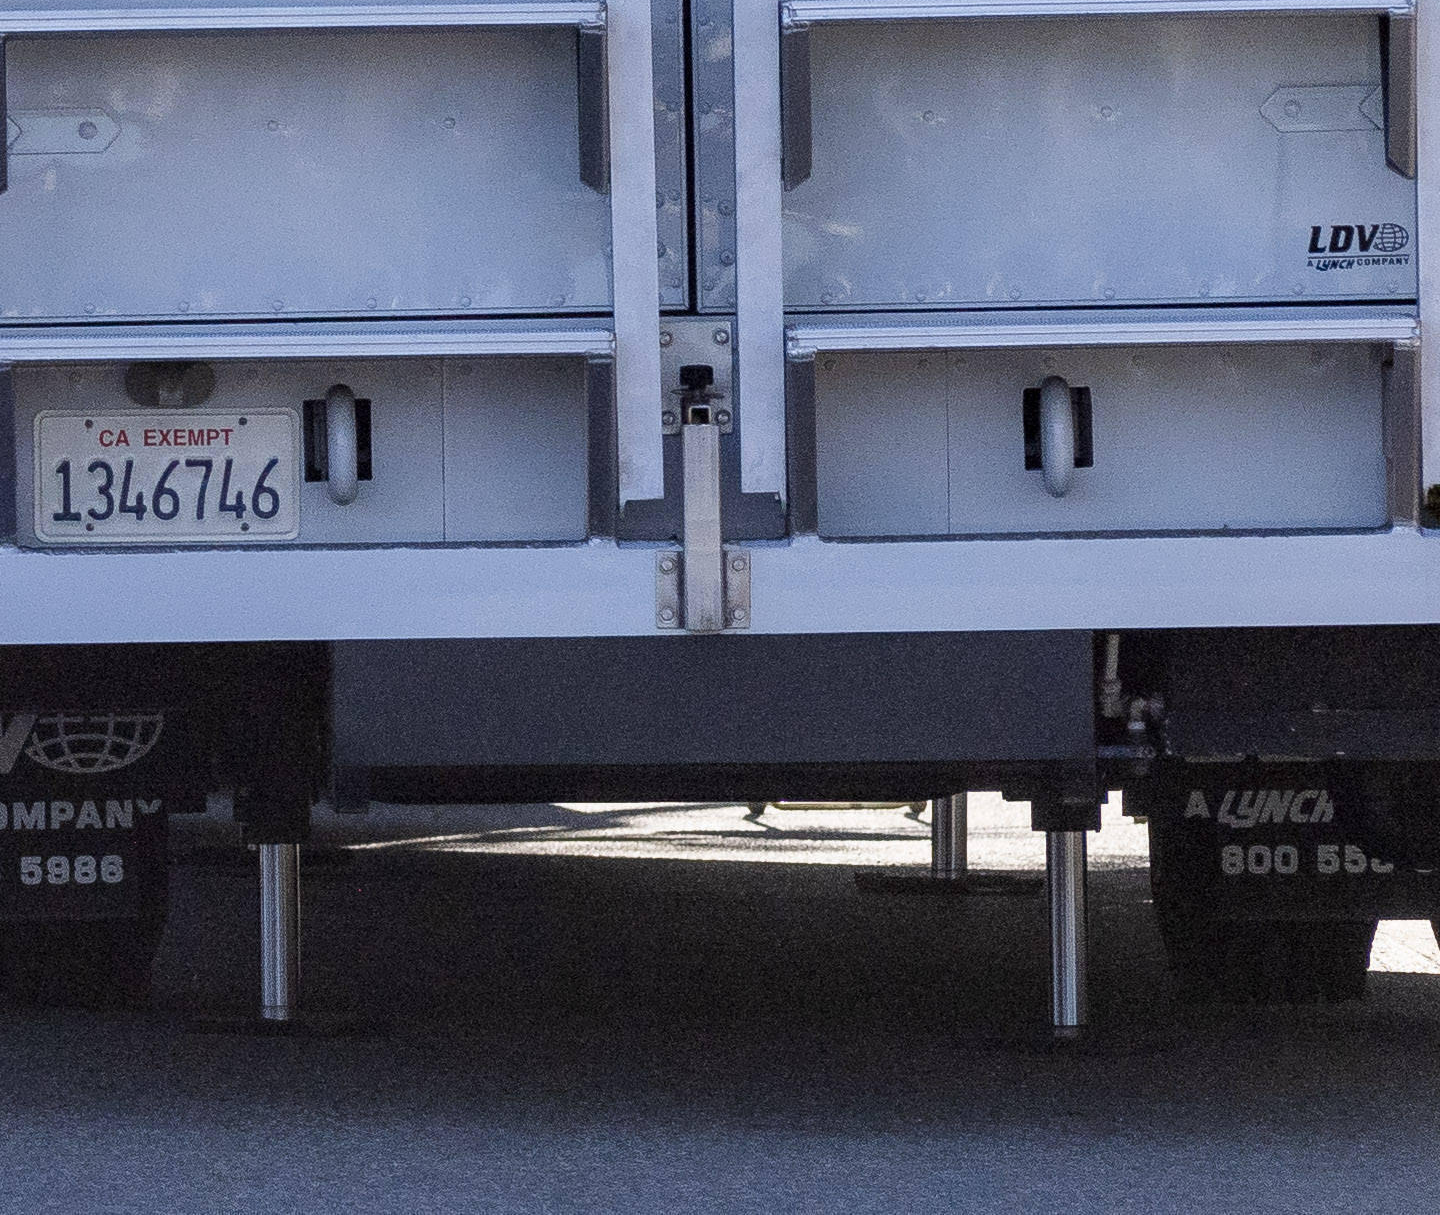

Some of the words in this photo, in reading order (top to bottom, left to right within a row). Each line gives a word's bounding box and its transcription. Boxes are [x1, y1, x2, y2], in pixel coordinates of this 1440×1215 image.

[1308, 224, 1380, 253] LDV
[1316, 258, 1355, 271] LYNCH
[1356, 257, 1409, 266] COMPANY
[99, 429, 130, 447] CA
[143, 428, 233, 446] EXEMPT
[53, 458, 280, 521] 1346746
[1184, 791, 1210, 819] A
[20, 855, 123, 884] 5986
[1222, 845, 1298, 874] 800
